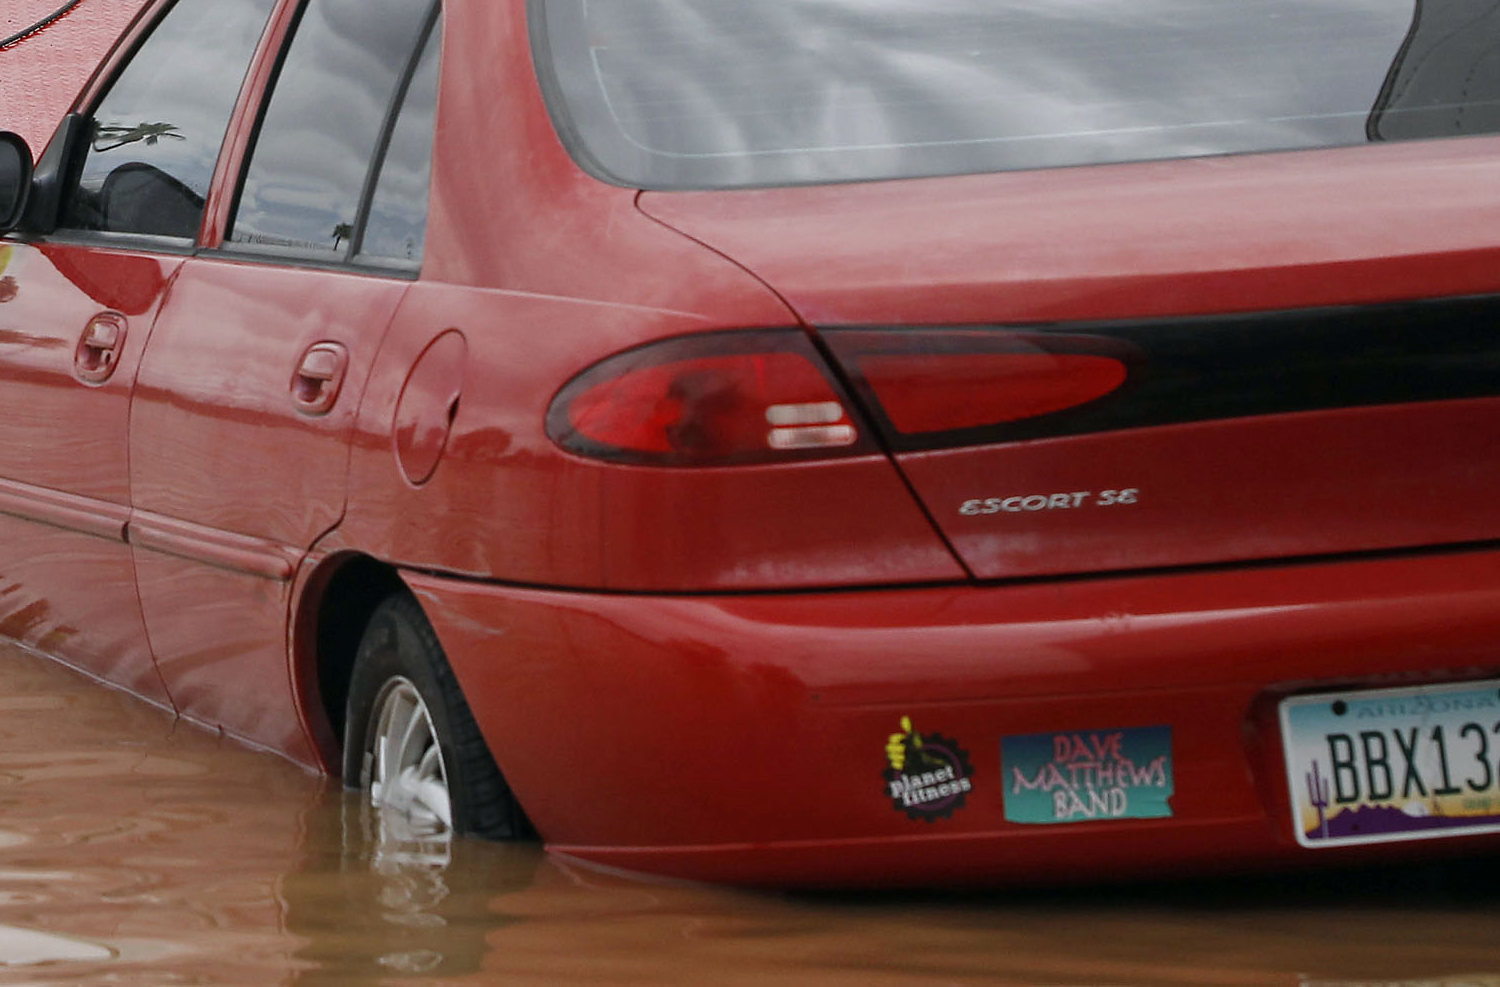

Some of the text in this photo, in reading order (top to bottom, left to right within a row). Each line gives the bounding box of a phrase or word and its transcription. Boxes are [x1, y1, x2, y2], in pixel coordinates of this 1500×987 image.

[959, 488, 1139, 515] ESCORT SE
[1355, 694, 1496, 719] ARIZONA
[1053, 732, 1124, 763] DAVE
[889, 764, 955, 799] planet
[1012, 756, 1168, 795] MATTHEWS
[902, 777, 972, 807] fitness
[1053, 787, 1128, 820] BAND
